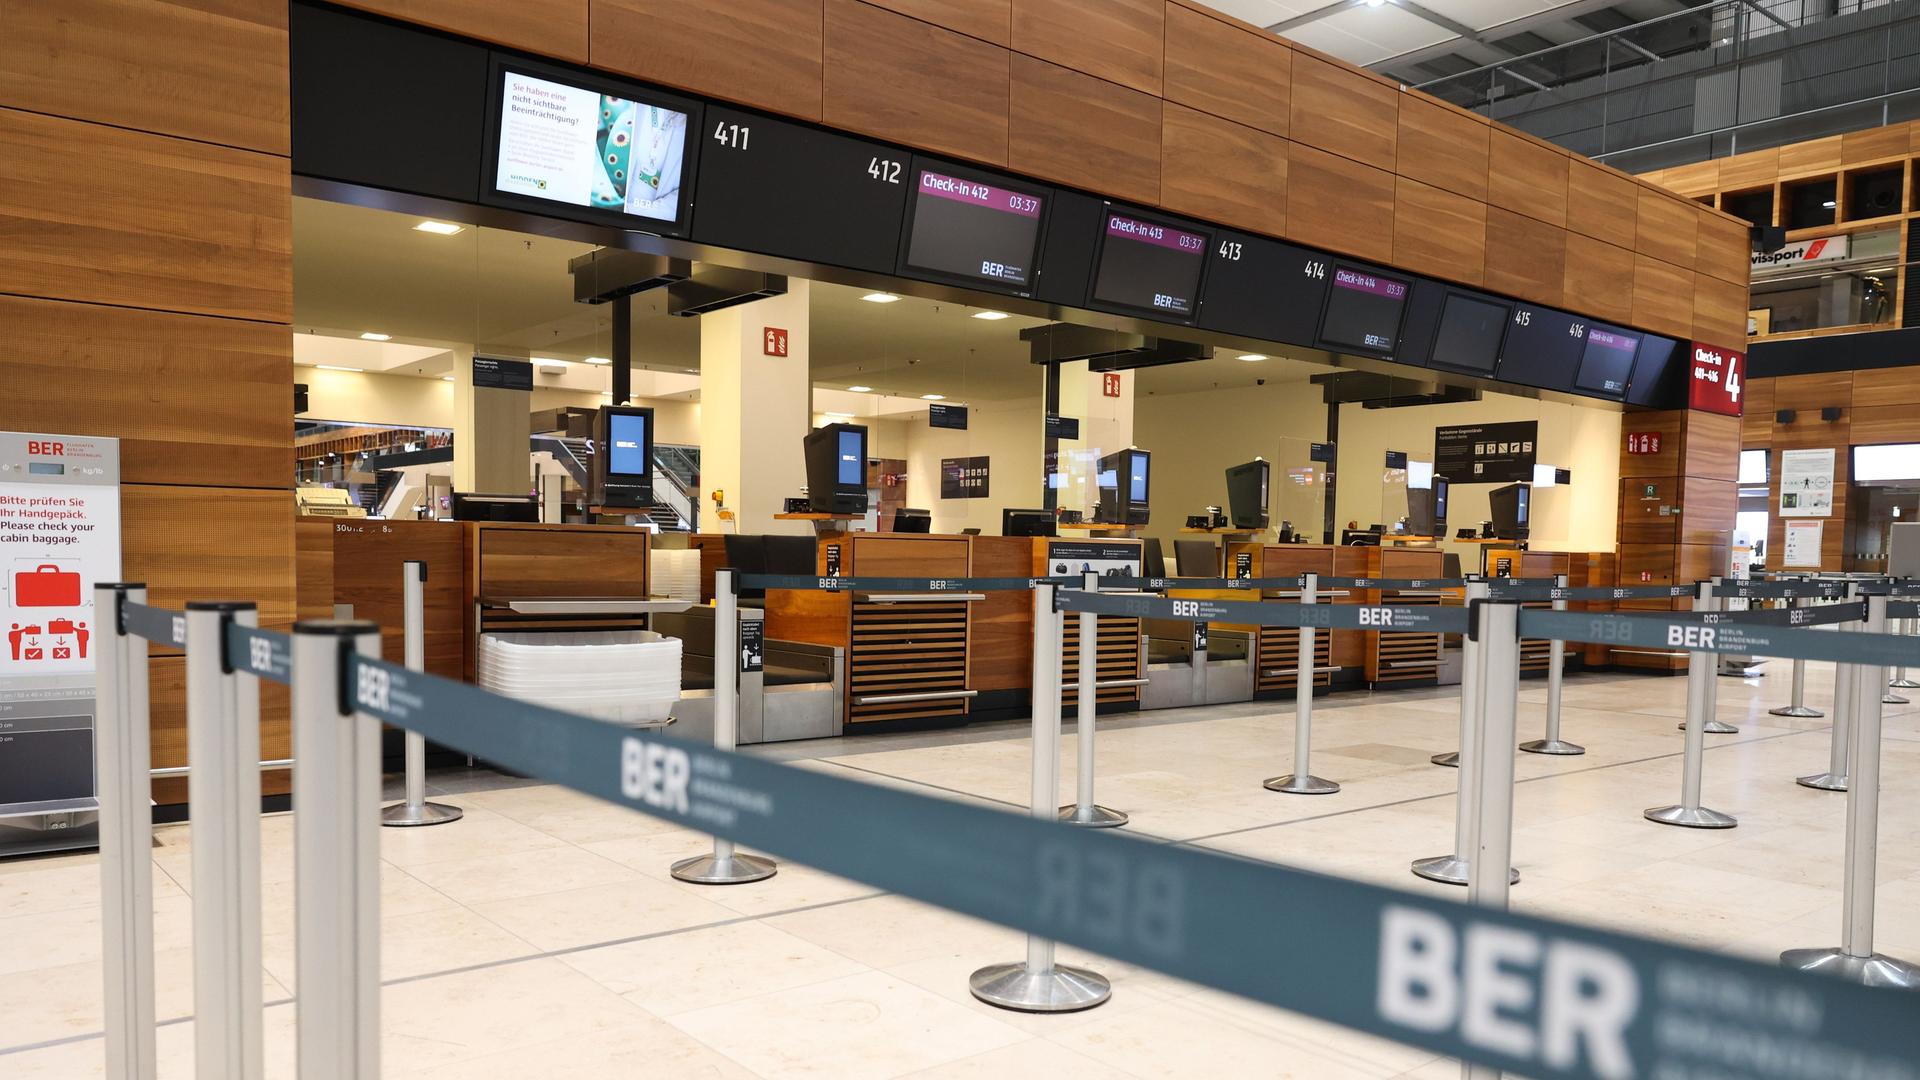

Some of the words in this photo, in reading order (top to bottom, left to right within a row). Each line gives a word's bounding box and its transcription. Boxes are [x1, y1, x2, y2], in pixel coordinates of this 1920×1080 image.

[512, 83, 525, 92] Sie
[526, 85, 549, 97] haben
[550, 93, 567, 101] eine
[512, 94, 531, 104] nicht
[532, 98, 567, 112] sichtbare
[511, 104, 579, 126] Beeinträchtigung?
[713, 121, 749, 150] 411
[867, 157, 901, 184] 412
[923, 174, 969, 196] Check-In
[971, 185, 989, 200] 412
[1009, 195, 1037, 212] 03:37
[633, 198, 652, 209] BER
[1110, 217, 1148, 236] Check-In
[1148, 227, 1163, 240] 413
[1179, 235, 1202, 250] 03:37
[1219, 240, 1242, 260] 413
[981, 261, 1004, 278] BER
[1304, 260, 1324, 280] 414
[1336, 271, 1364, 285] Check-In
[1364, 278, 1376, 288] 414
[1153, 293, 1173, 308] BER
[1515, 310, 1531, 326] 415
[1569, 323, 1584, 338] 416
[1364, 334, 1379, 346] BER
[1725, 357, 1740, 403] 4
[28, 441, 64, 456] BER
[0, 496, 26, 505] Bitte
[30, 496, 66, 507] prüfen
[69, 498, 84, 506] Sie
[0, 509, 15, 517] Ihr
[19, 509, 87, 520] Handgepäck.
[0, 521, 35, 531] Please
[38, 522, 68, 531] check
[71, 524, 95, 533] your
[0, 534, 29, 543] cabin
[32, 534, 80, 545] baggage.
[819, 578, 838, 589] BER
[930, 580, 946, 590] BER
[1150, 579, 1163, 588] BER
[1227, 579, 1240, 588] BER
[1355, 579, 1365, 587] BER
[1412, 580, 1421, 588] BER
[1551, 589, 1562, 599] BER
[1613, 589, 1624, 598] BER
[1670, 587, 1680, 596] BER
[1173, 600, 1199, 617] BER
[1359, 607, 1392, 626] BER
[1790, 609, 1804, 624] BER
[1667, 624, 1716, 649] BER
[1719, 628, 1743, 636] BERLIN
[1719, 635, 1770, 646] BRANDENBURG
[250, 636, 272, 672] BER
[357, 662, 390, 713] BER
[620, 736, 690, 817] BER
[1377, 906, 1639, 1080] BER
